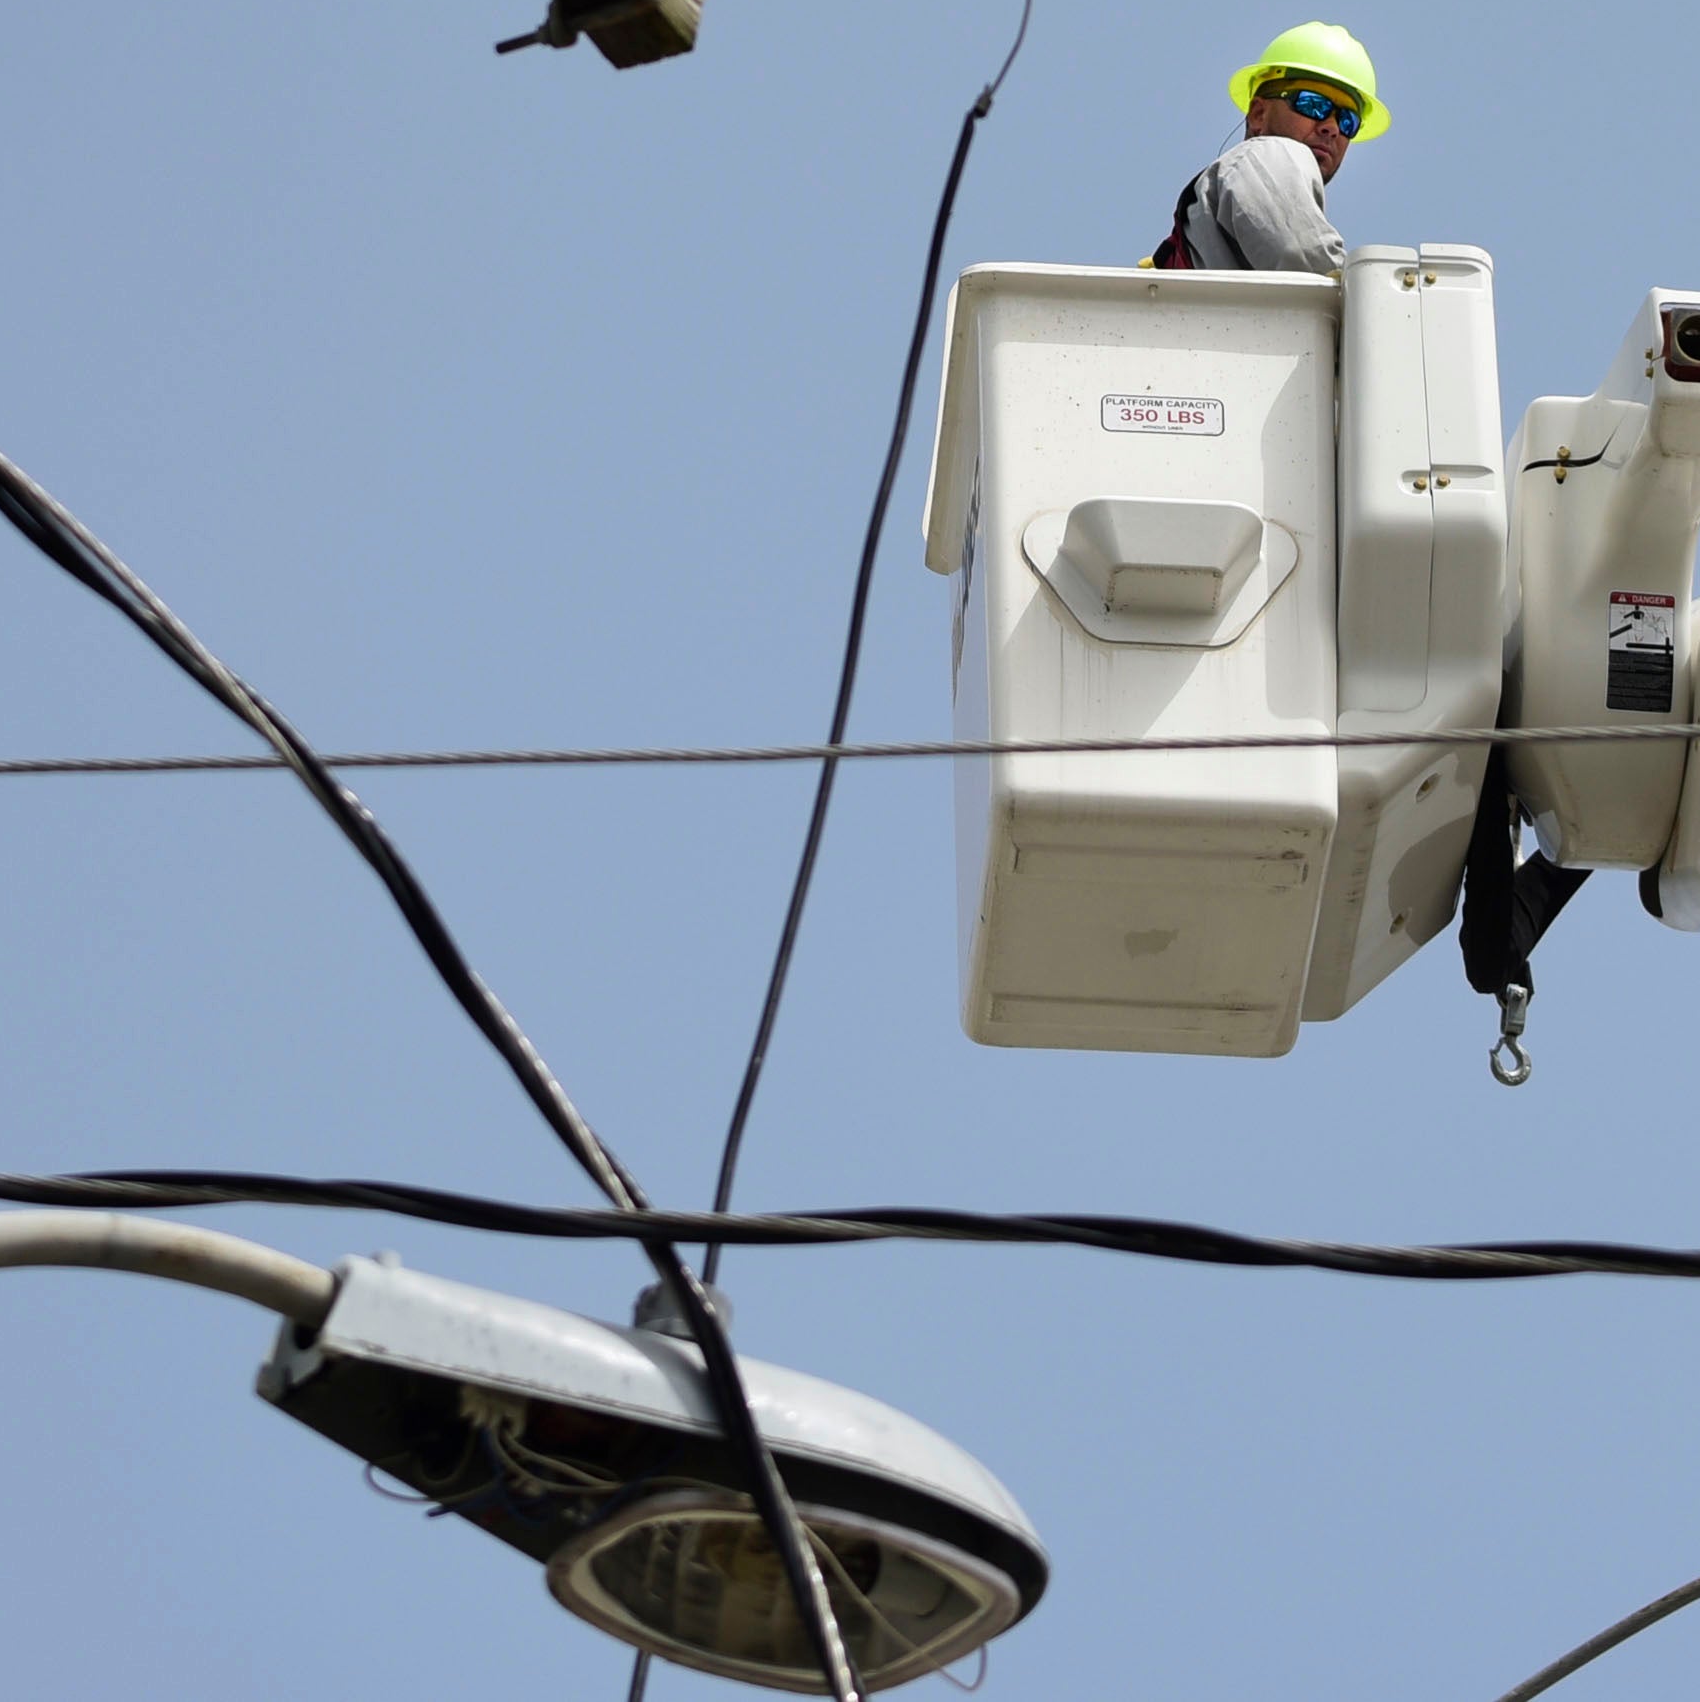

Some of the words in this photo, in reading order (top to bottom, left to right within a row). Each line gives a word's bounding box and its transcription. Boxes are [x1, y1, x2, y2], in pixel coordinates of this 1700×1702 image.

[1105, 398, 1163, 408] PLATFORM
[1166, 400, 1219, 410] CAPACITY
[1120, 408, 1158, 423] 350
[1167, 410, 1205, 425] LBS
[1631, 595, 1666, 605] DANGER
